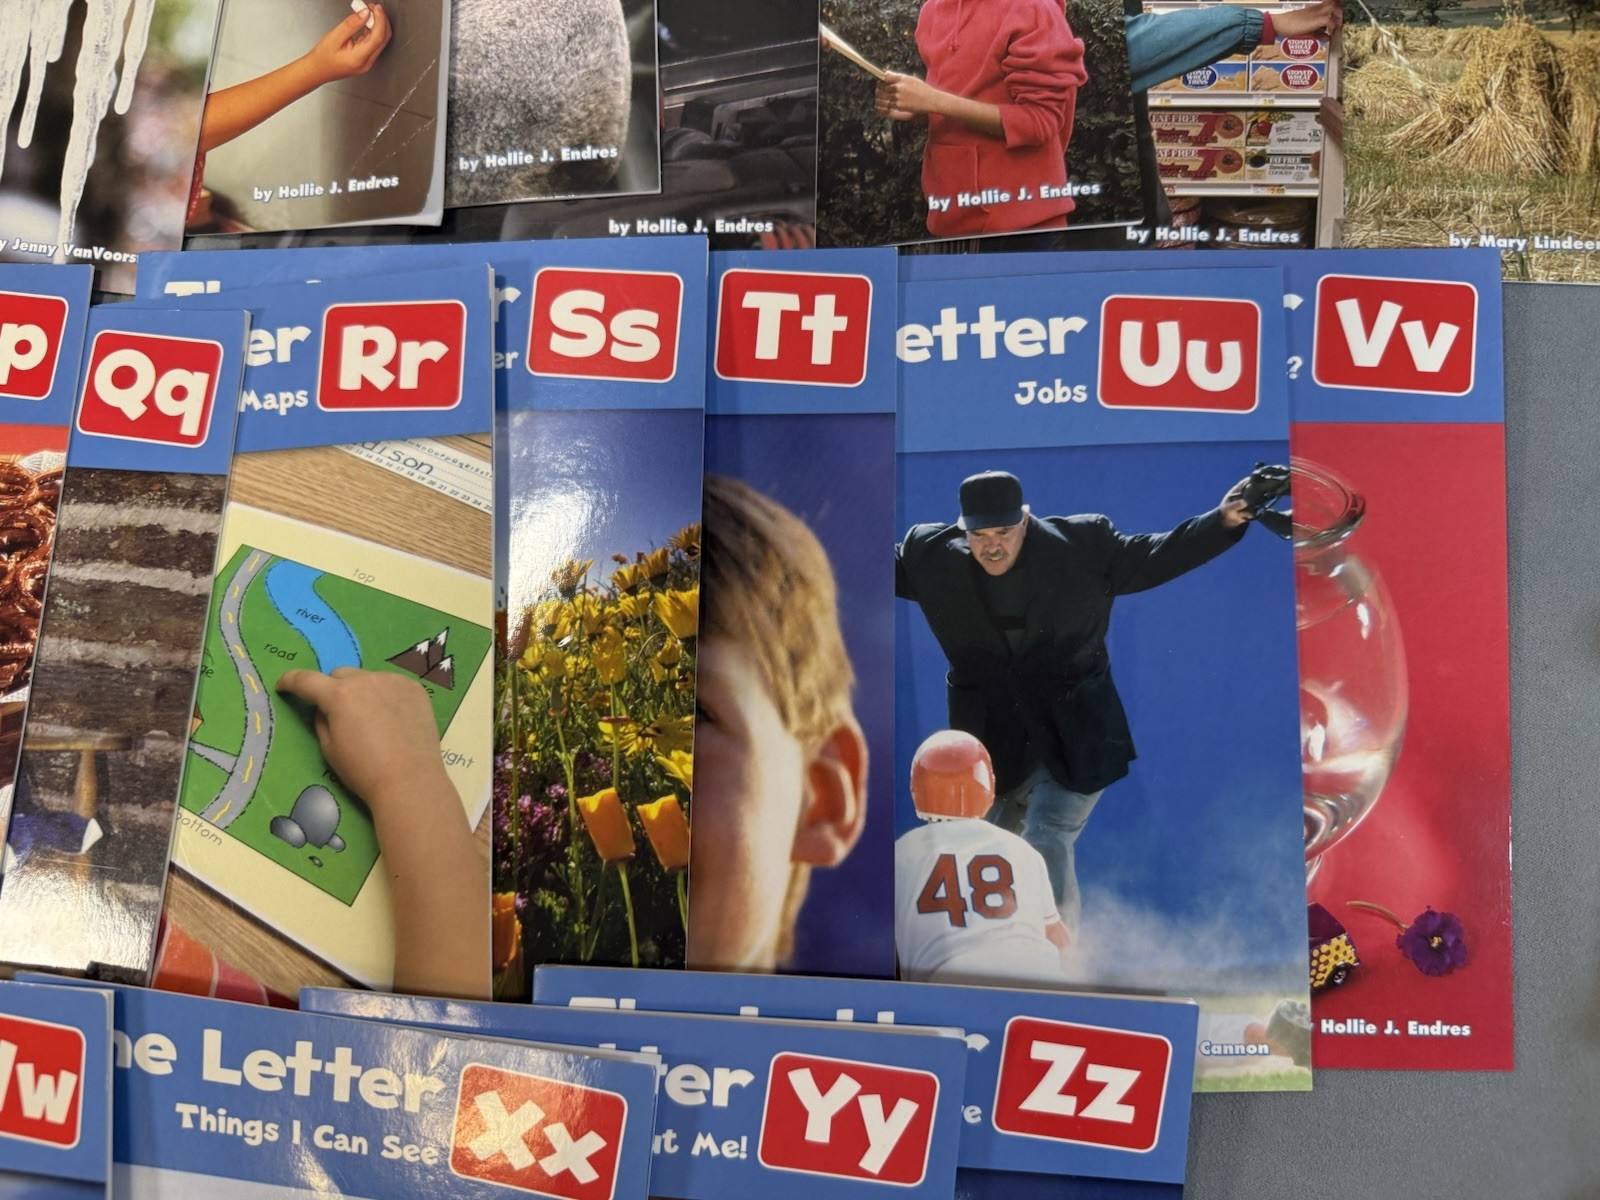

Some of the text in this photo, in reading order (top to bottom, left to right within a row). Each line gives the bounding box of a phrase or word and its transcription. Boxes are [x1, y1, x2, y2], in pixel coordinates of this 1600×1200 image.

[459, 145, 618, 173] by Hollie J. Endres
[253, 175, 399, 203] by Hollie J. Endres
[928, 182, 1101, 212] by Hollie J. Endres
[608, 218, 774, 237] by Hollie J. Endres
[1126, 226, 1300, 244] by Hollie J. Endres
[1449, 233, 1473, 249] by
[1479, 234, 1527, 252] Mary
[12, 238, 57, 258] Jenny
[63, 243, 139, 263] VanVoors
[549, 289, 661, 362] Ss
[741, 291, 848, 365] Tt
[1335, 298, 1459, 373] Vv
[339, 324, 450, 392] Rr
[1119, 320, 1242, 392] Uu
[94, 348, 209, 436] Qq
[240, 389, 308, 415] Maps
[1014, 380, 1088, 405] Jobs
[354, 441, 433, 474] dison
[353, 567, 375, 583] top
[295, 608, 326, 624] river
[264, 644, 297, 661] road
[916, 853, 1018, 928] 48
[1320, 1019, 1377, 1035] Hollie
[1384, 1020, 1400, 1035] J.
[1407, 1020, 1472, 1037] Endres
[1199, 1040, 1270, 1056] Cannon
[202, 1028, 447, 1113] Letter
[660, 1063, 755, 1107] er
[1018, 1040, 1142, 1124] Zz
[175, 1102, 439, 1165] Things I Can See
[468, 1088, 607, 1185] Xx
[786, 1067, 919, 1176] Yy
[691, 1131, 748, 1159] Me!
